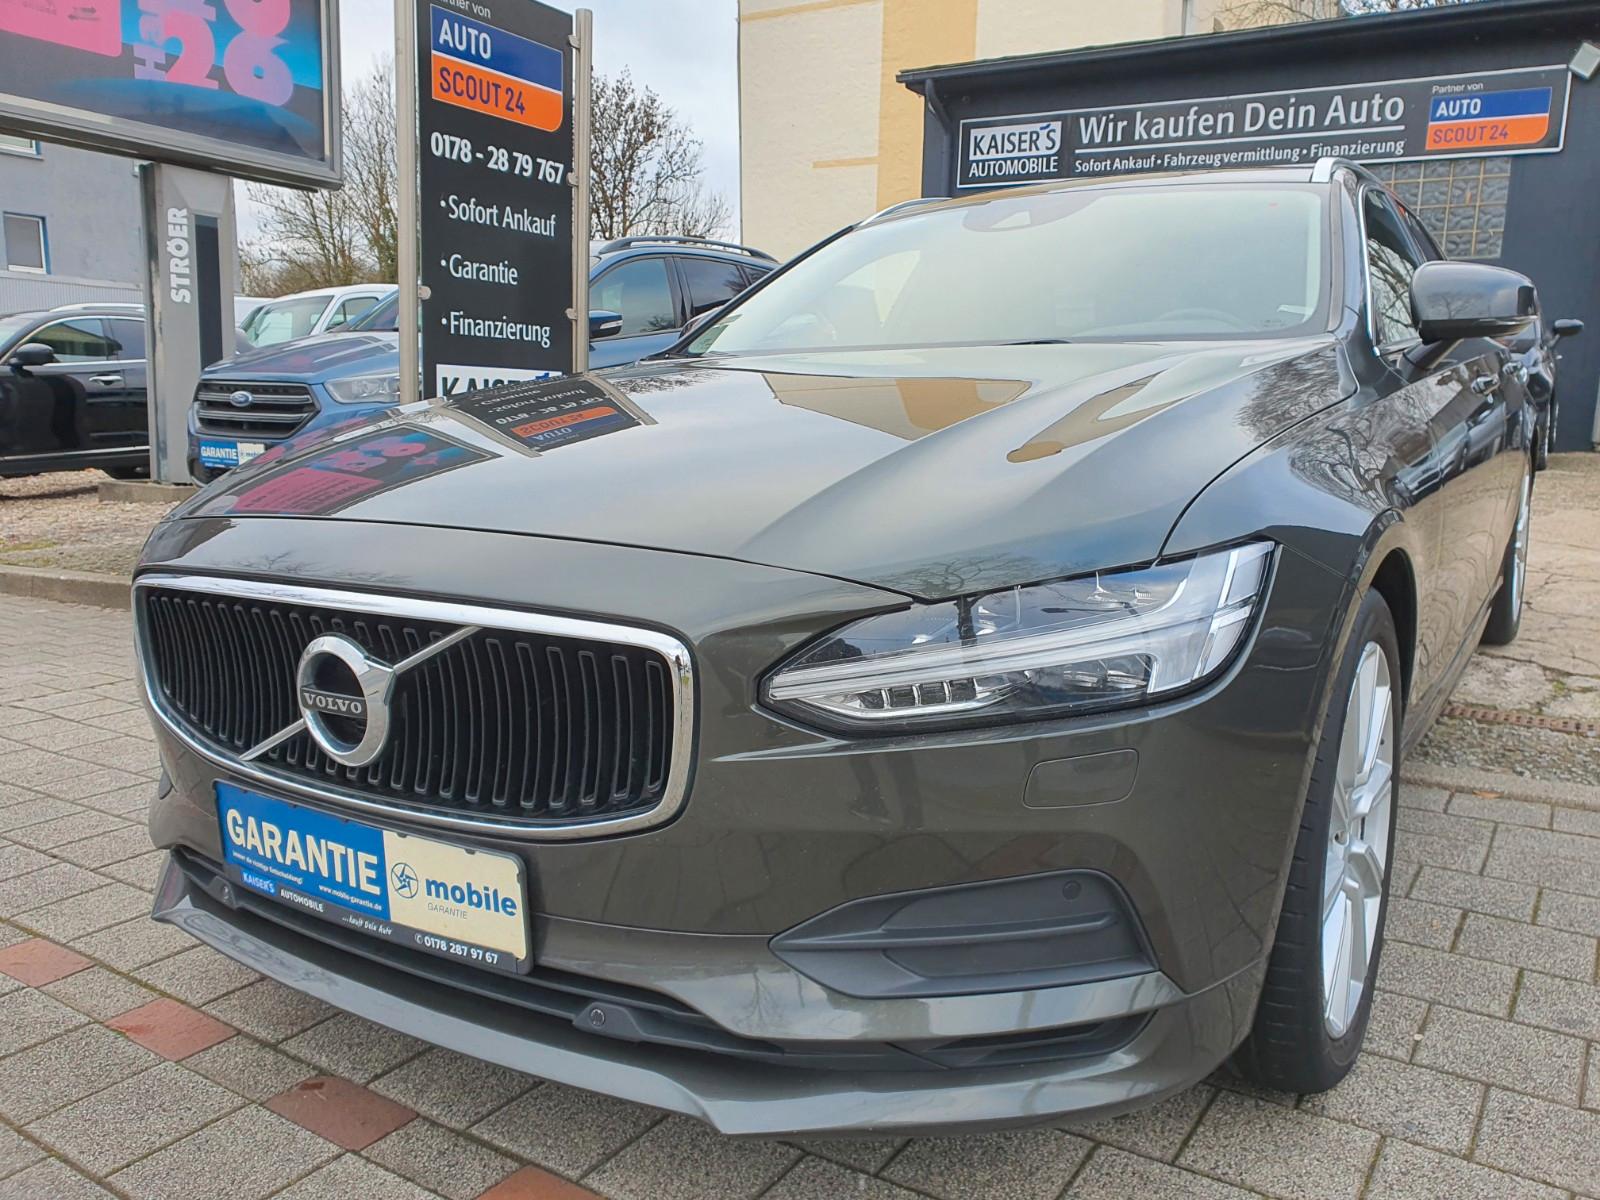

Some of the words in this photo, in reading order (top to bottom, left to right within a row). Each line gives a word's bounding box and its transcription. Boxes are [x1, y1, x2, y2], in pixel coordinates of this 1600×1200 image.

[472, 3, 491, 19] von
[439, 18, 492, 60] AUTO
[1432, 84, 1465, 94] Partner
[1467, 82, 1484, 91] von
[1079, 116, 1130, 145] Wir
[1134, 106, 1236, 142] kaufen
[1244, 97, 1318, 133] Dein
[1323, 92, 1405, 126] Auto
[1435, 98, 1482, 118] AUTO
[430, 131, 472, 164] 0178
[487, 145, 510, 172] 28
[512, 151, 533, 178] 79
[536, 157, 565, 185] 767
[969, 156, 1058, 178] AUTOMOBILE
[1074, 158, 1111, 173] Sofort
[1112, 155, 1157, 171] Ankauf
[1164, 146, 1301, 168] Fahrzeugvermittlung
[1310, 138, 1405, 159] Finanzierung
[448, 194, 499, 228] Sofort
[502, 206, 557, 238] Ankauf
[166, 207, 192, 304] STRÖER
[449, 253, 519, 286] Garantie
[450, 311, 552, 349] Finanzierung
[200, 446, 238, 460] GARANTIE
[303, 692, 362, 714] VOLVO
[226, 808, 381, 896] GARANTIE
[425, 878, 518, 917] mobile
[427, 902, 468, 920] GARANTIE
[280, 888, 324, 913] AUTOMOBILE
[424, 935, 447, 951] 0178
[449, 942, 468, 957] 287
[470, 948, 483, 961] 97
[486, 952, 499, 965] 67
